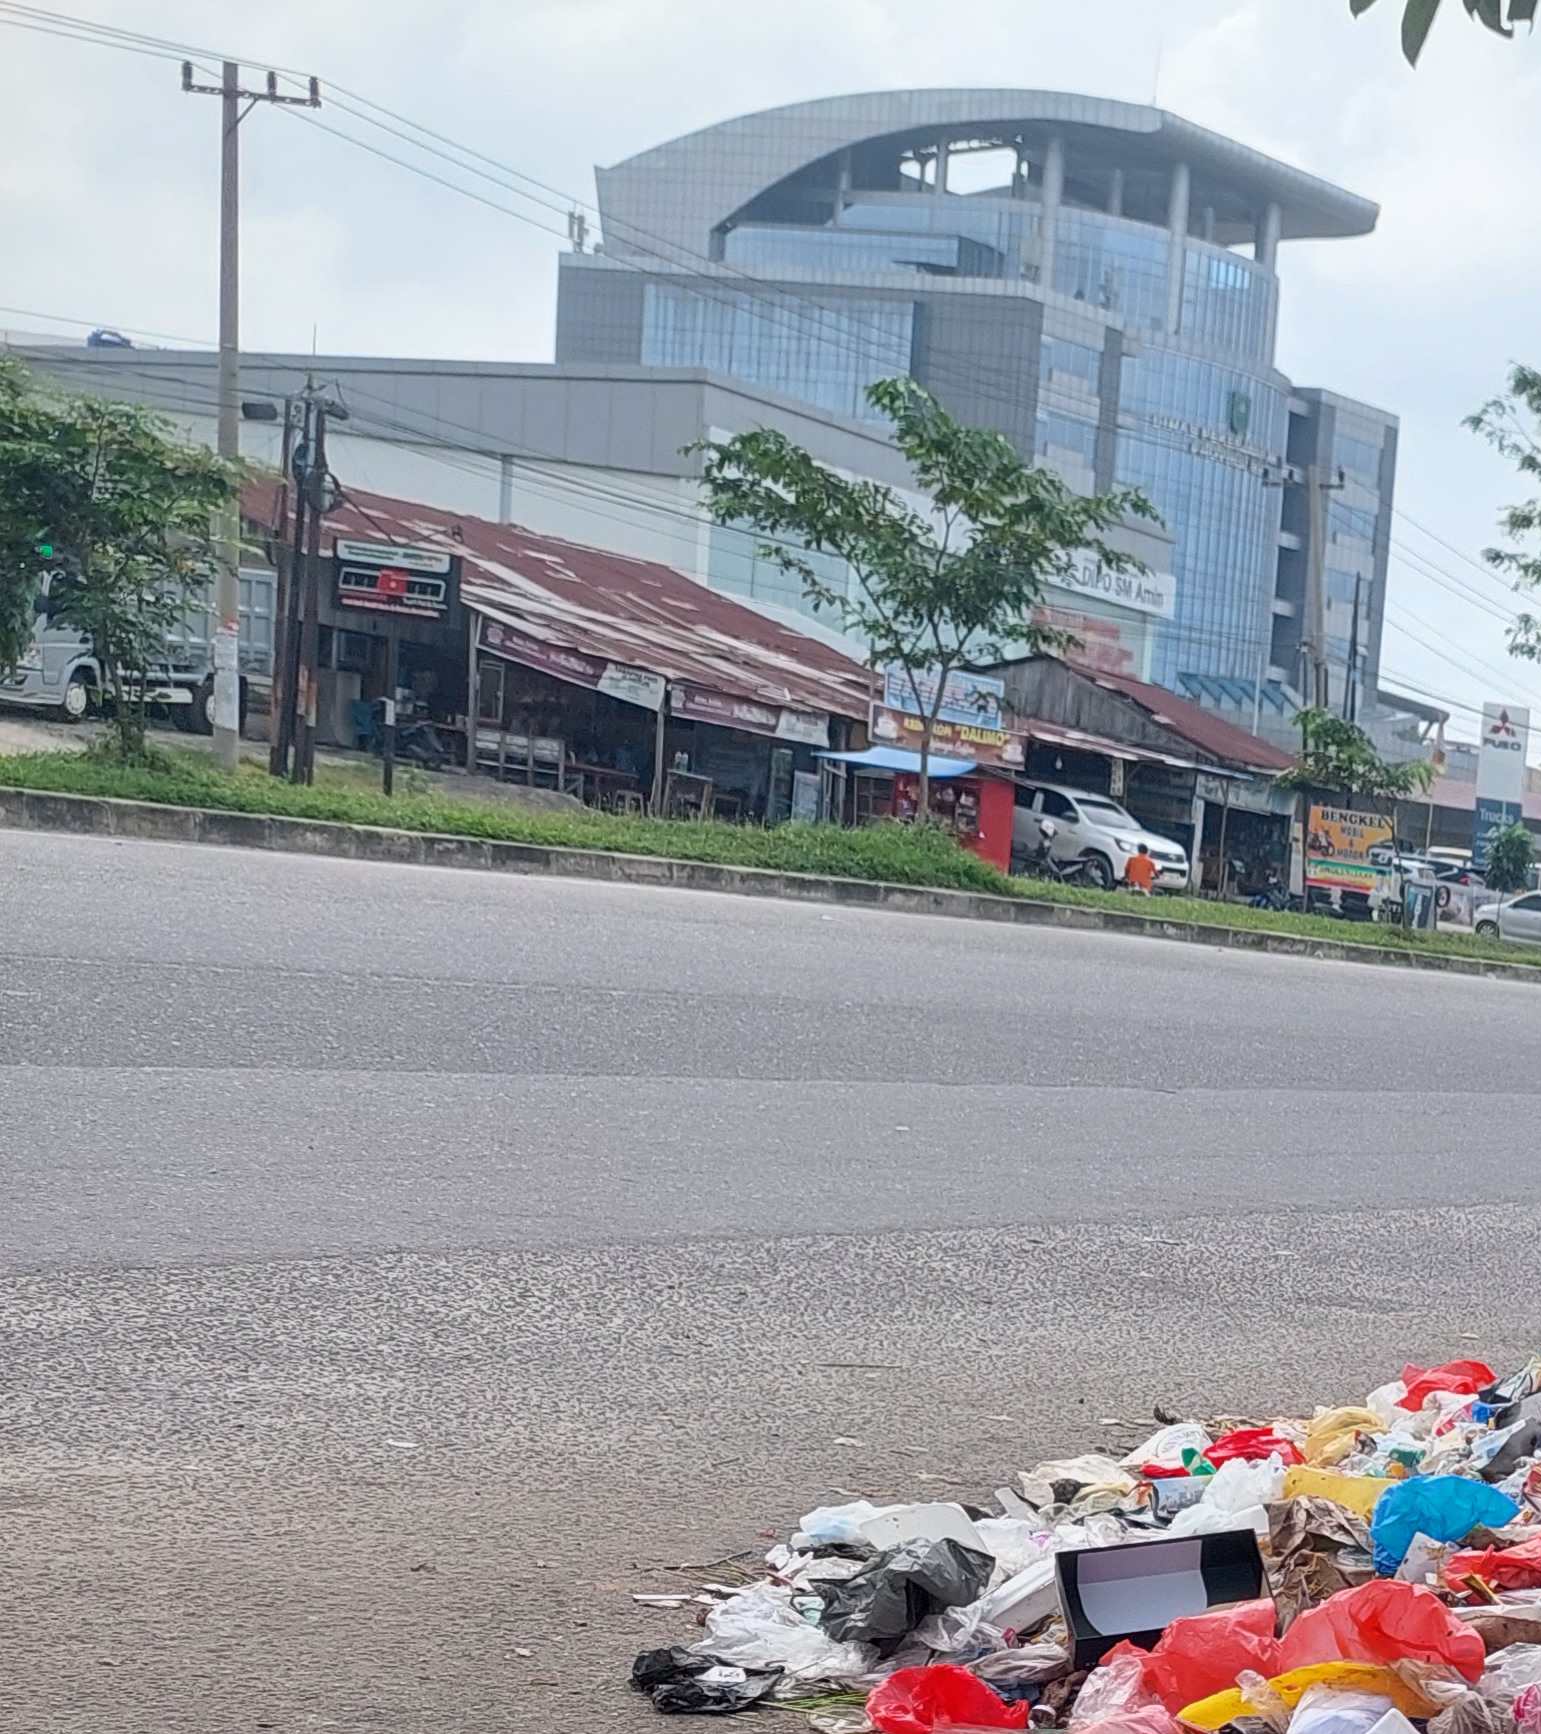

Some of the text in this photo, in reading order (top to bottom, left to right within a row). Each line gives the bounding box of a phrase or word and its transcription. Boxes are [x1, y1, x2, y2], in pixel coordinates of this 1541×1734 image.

[1482, 738, 1522, 751] FUSO
[1320, 810, 1386, 829] BENGKEL
[1480, 808, 1514, 825] Trucks
